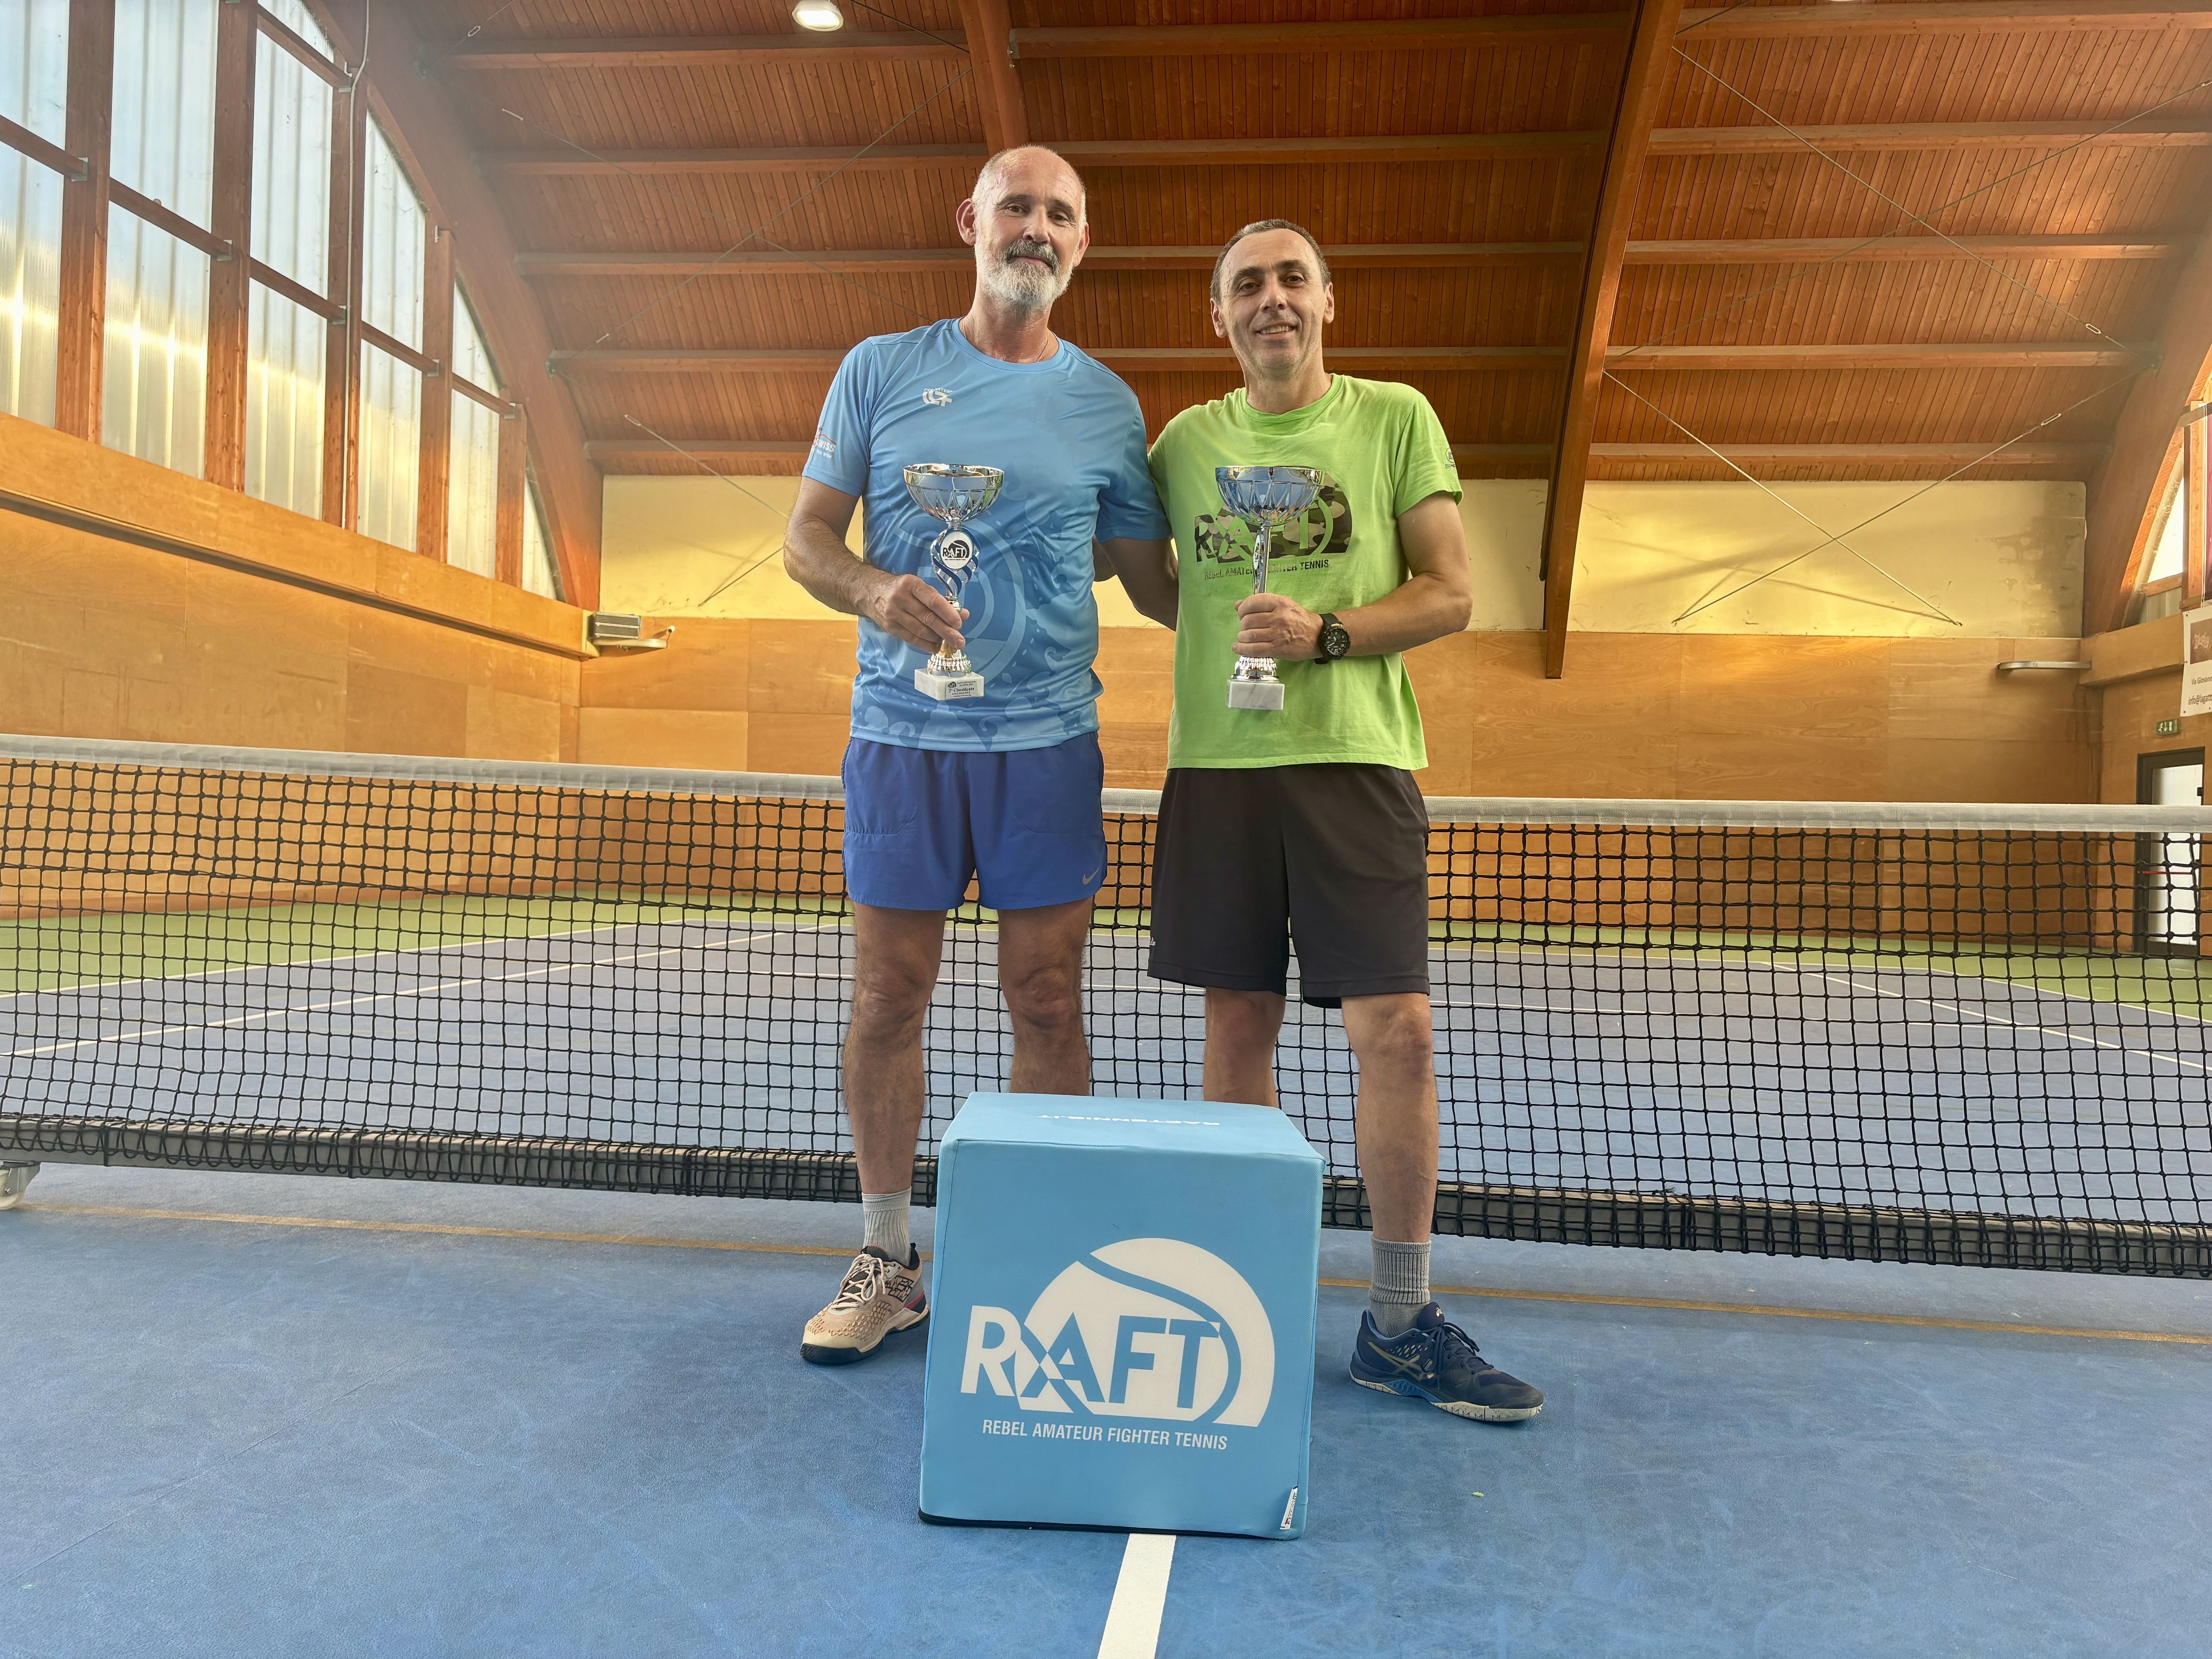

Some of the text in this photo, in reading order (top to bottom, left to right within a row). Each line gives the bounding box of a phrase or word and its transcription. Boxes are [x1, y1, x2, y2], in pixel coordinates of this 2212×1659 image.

[943, 547, 966, 557] RAFT
[1205, 570, 1224, 580] REBEL
[1300, 560, 1329, 570] TENNIS
[960, 1305, 1220, 1409] RAFT
[982, 1419, 1228, 1450] REBEL AMATEUR FIGHTER TENNIS
